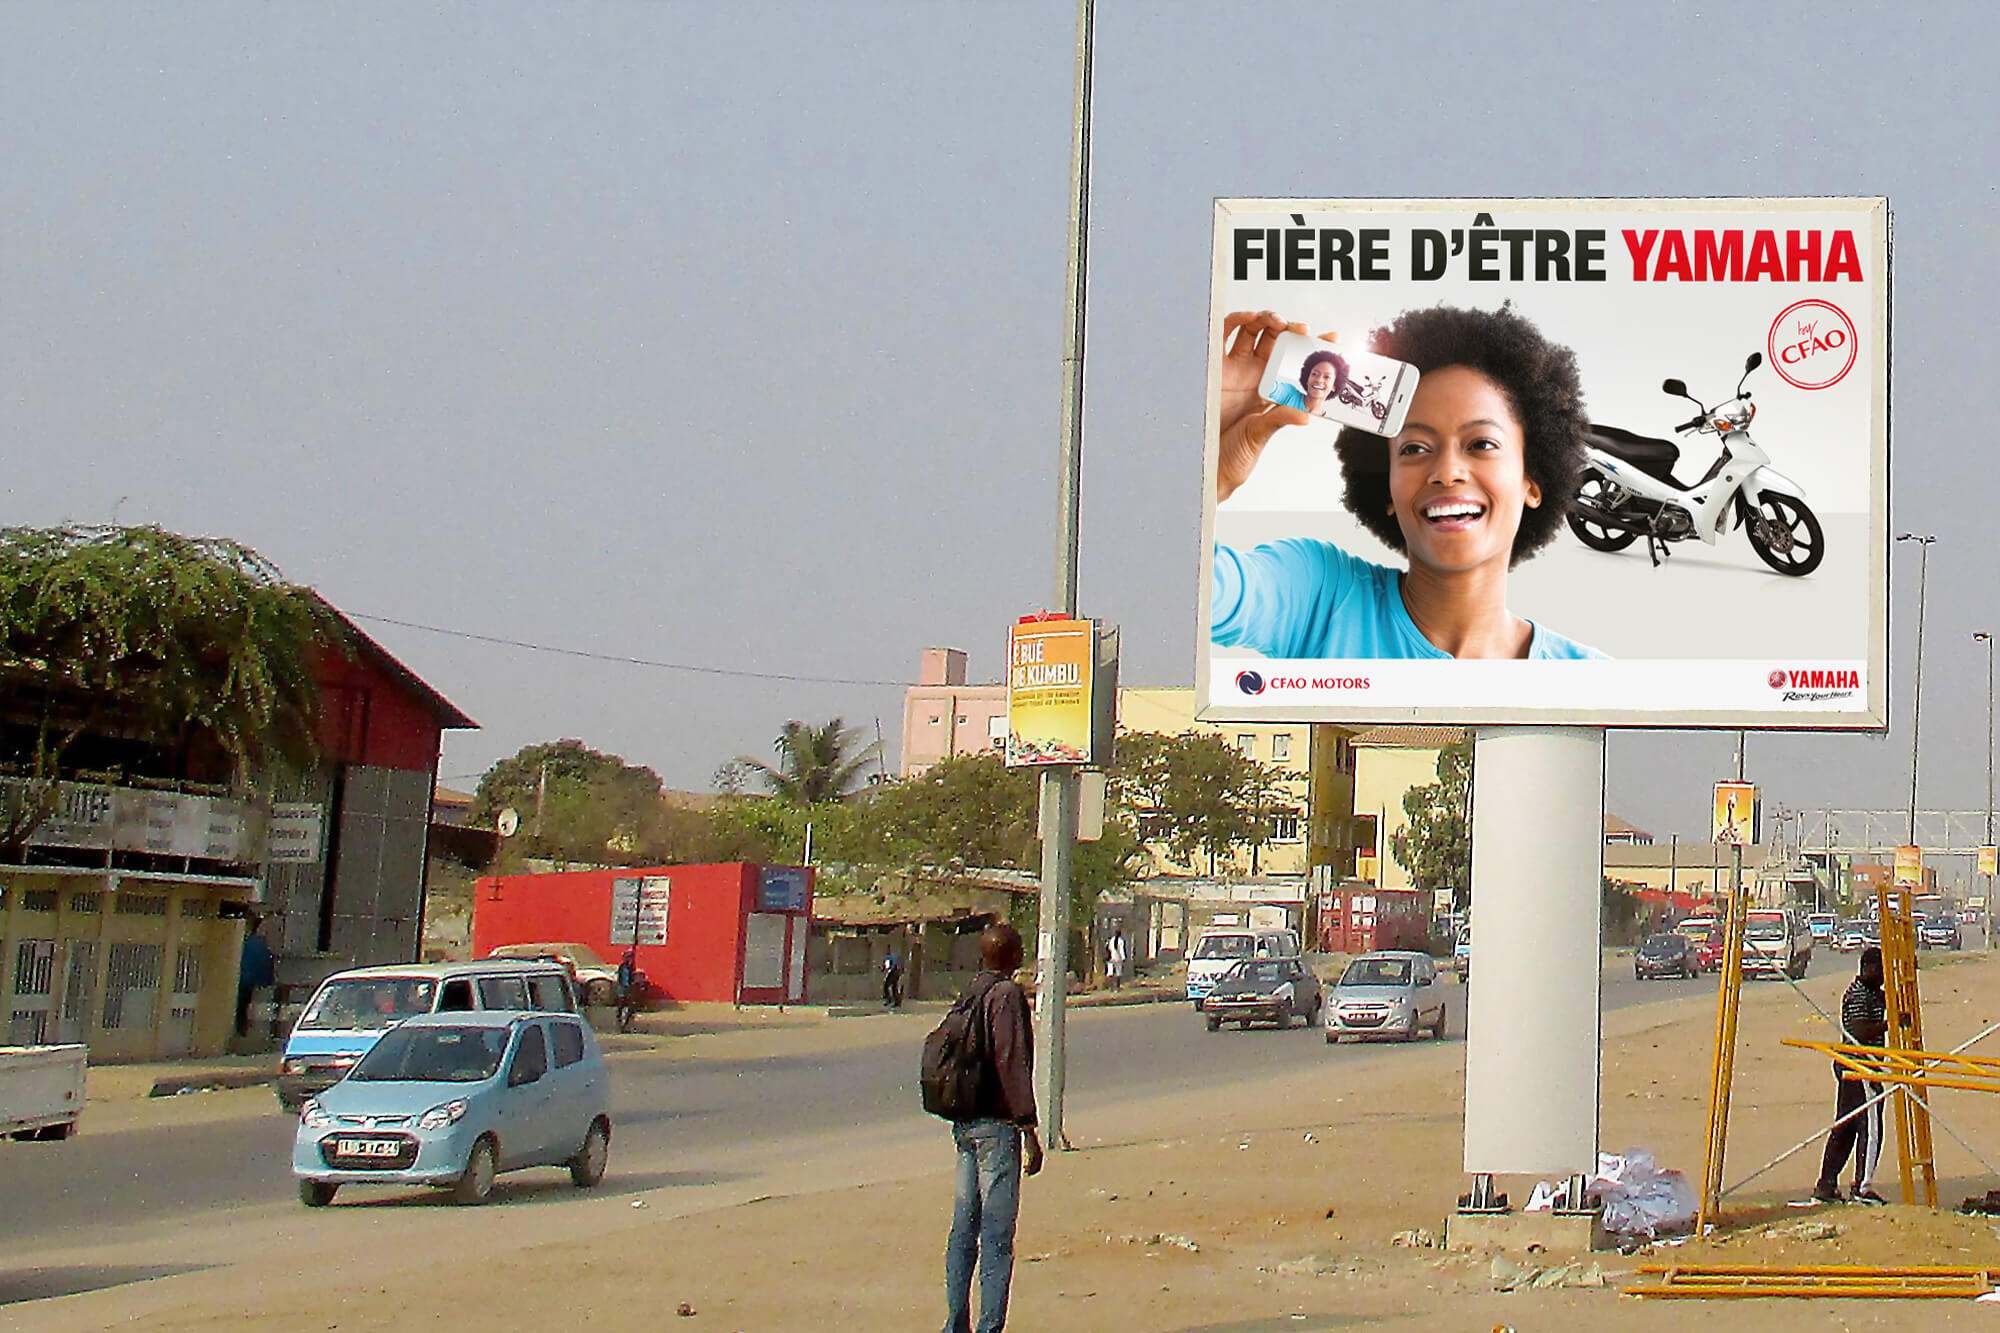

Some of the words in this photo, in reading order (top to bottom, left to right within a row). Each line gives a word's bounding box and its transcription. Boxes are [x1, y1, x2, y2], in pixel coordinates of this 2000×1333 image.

[1233, 214, 1391, 281] FIÈRE
[1621, 230, 1865, 283] YAMAHA
[1781, 329, 1846, 364] CFAO
[1270, 677, 1307, 690] CFAO
[1311, 677, 1371, 690] MOTORS
[1788, 670, 1860, 688] YAMAHA
